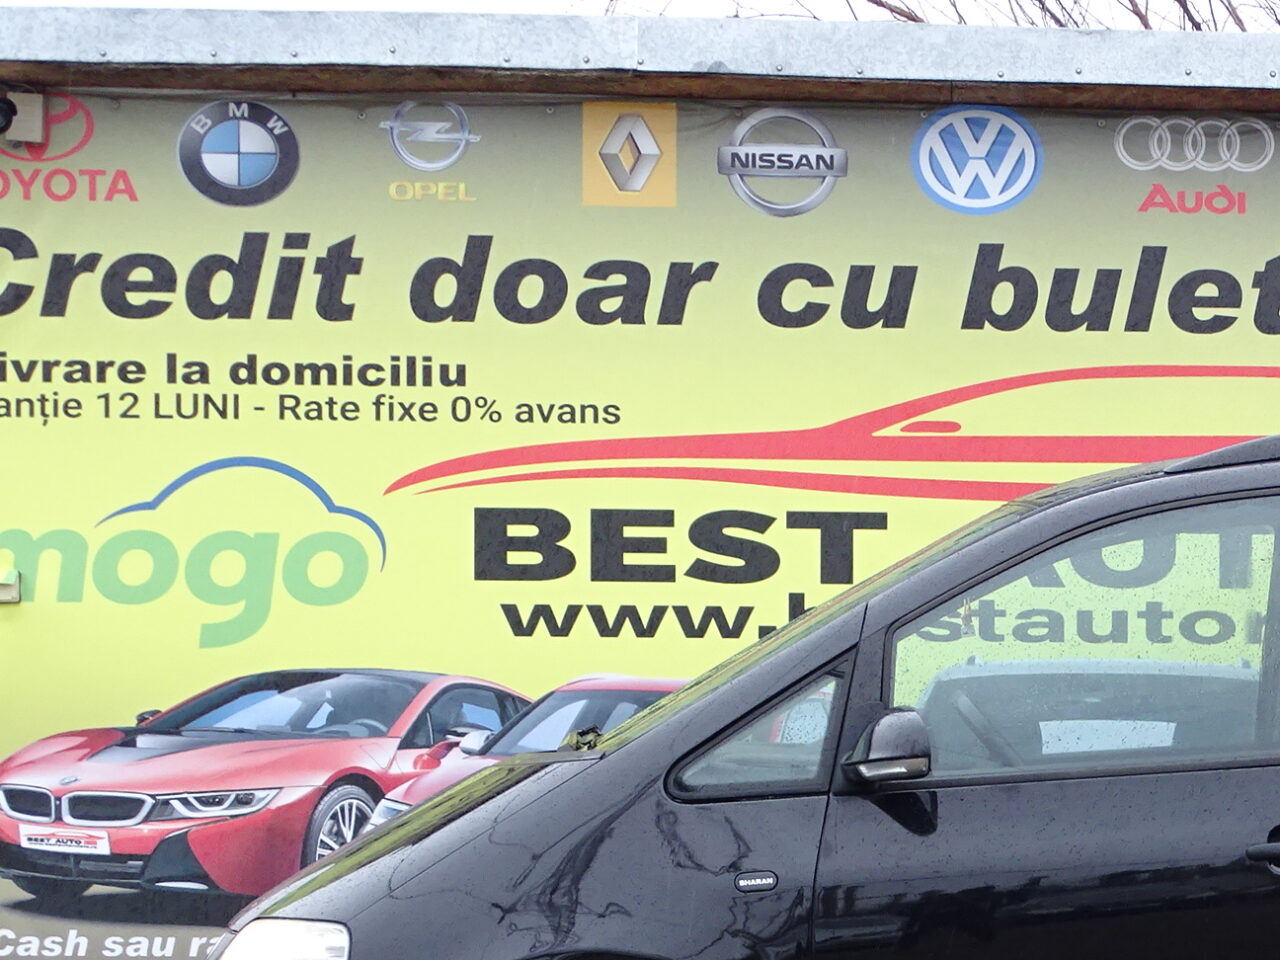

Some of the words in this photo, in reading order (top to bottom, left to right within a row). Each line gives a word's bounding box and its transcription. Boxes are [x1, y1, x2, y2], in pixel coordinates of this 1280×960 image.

[190, 102, 289, 134] BMW
[729, 151, 836, 171] NISSAN
[388, 181, 477, 200] OPEL
[1137, 184, 1247, 214] Audi
[0, 227, 364, 322] Credit
[408, 234, 720, 325] doar
[757, 261, 918, 329] cu
[166, 353, 210, 385] la
[228, 354, 467, 387] domiciliu
[97, 392, 140, 418] 12
[154, 393, 240, 419] LUNI
[279, 394, 361, 421] Rate
[372, 394, 439, 422] fixe
[451, 395, 502, 422] 0%
[515, 401, 621, 424] avans
[474, 507, 888, 585] BEST
[0, 528, 369, 649] mogo
[0, 929, 89, 957] Cash
[102, 936, 176, 957] sau
